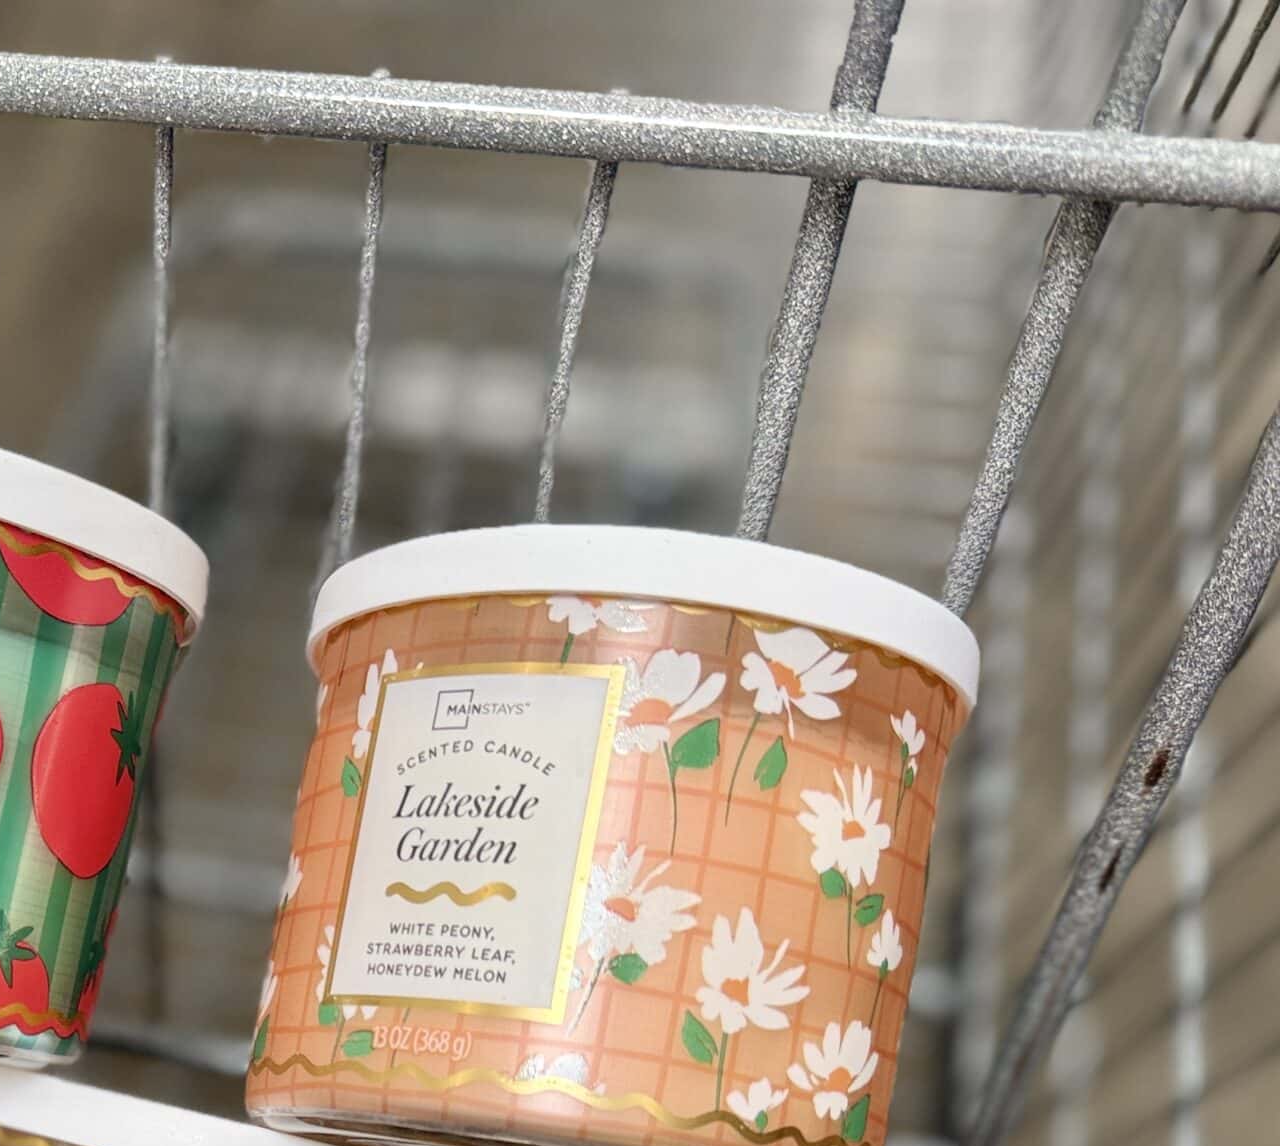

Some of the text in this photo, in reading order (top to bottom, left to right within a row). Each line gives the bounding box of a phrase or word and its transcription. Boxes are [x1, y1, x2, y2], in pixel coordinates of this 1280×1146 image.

[446, 703, 524, 716] MAINSTAYS
[396, 740, 556, 776] SCENTED CANDLE
[393, 782, 539, 821] Lakeside
[396, 827, 517, 864] Garden
[389, 922, 495, 941] WHITE PEONY,
[367, 942, 516, 965] STRAWBERRY LEAF,
[368, 963, 506, 983] HONEYDEW MELON
[390, 1027, 413, 1051] OZ
[414, 1028, 449, 1054] (368
[452, 1032, 472, 1060] g)
